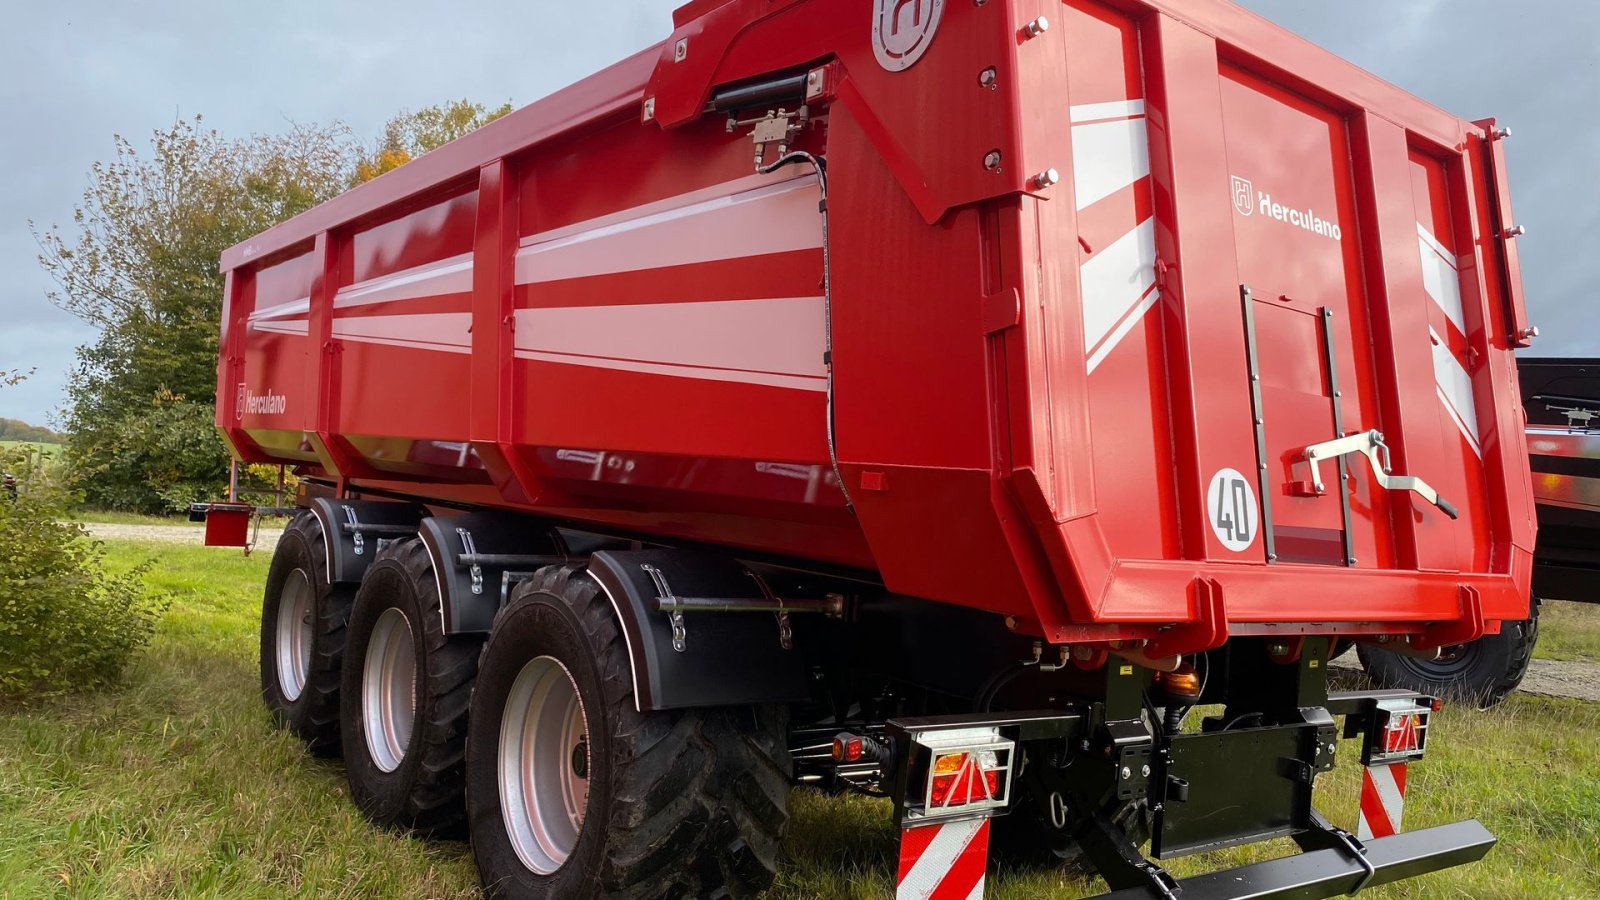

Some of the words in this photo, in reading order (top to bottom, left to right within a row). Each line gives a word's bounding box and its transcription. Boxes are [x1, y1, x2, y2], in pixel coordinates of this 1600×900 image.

[1258, 191, 1341, 240] Herculano
[245, 388, 286, 414] Herculano
[1217, 477, 1249, 542] 40
